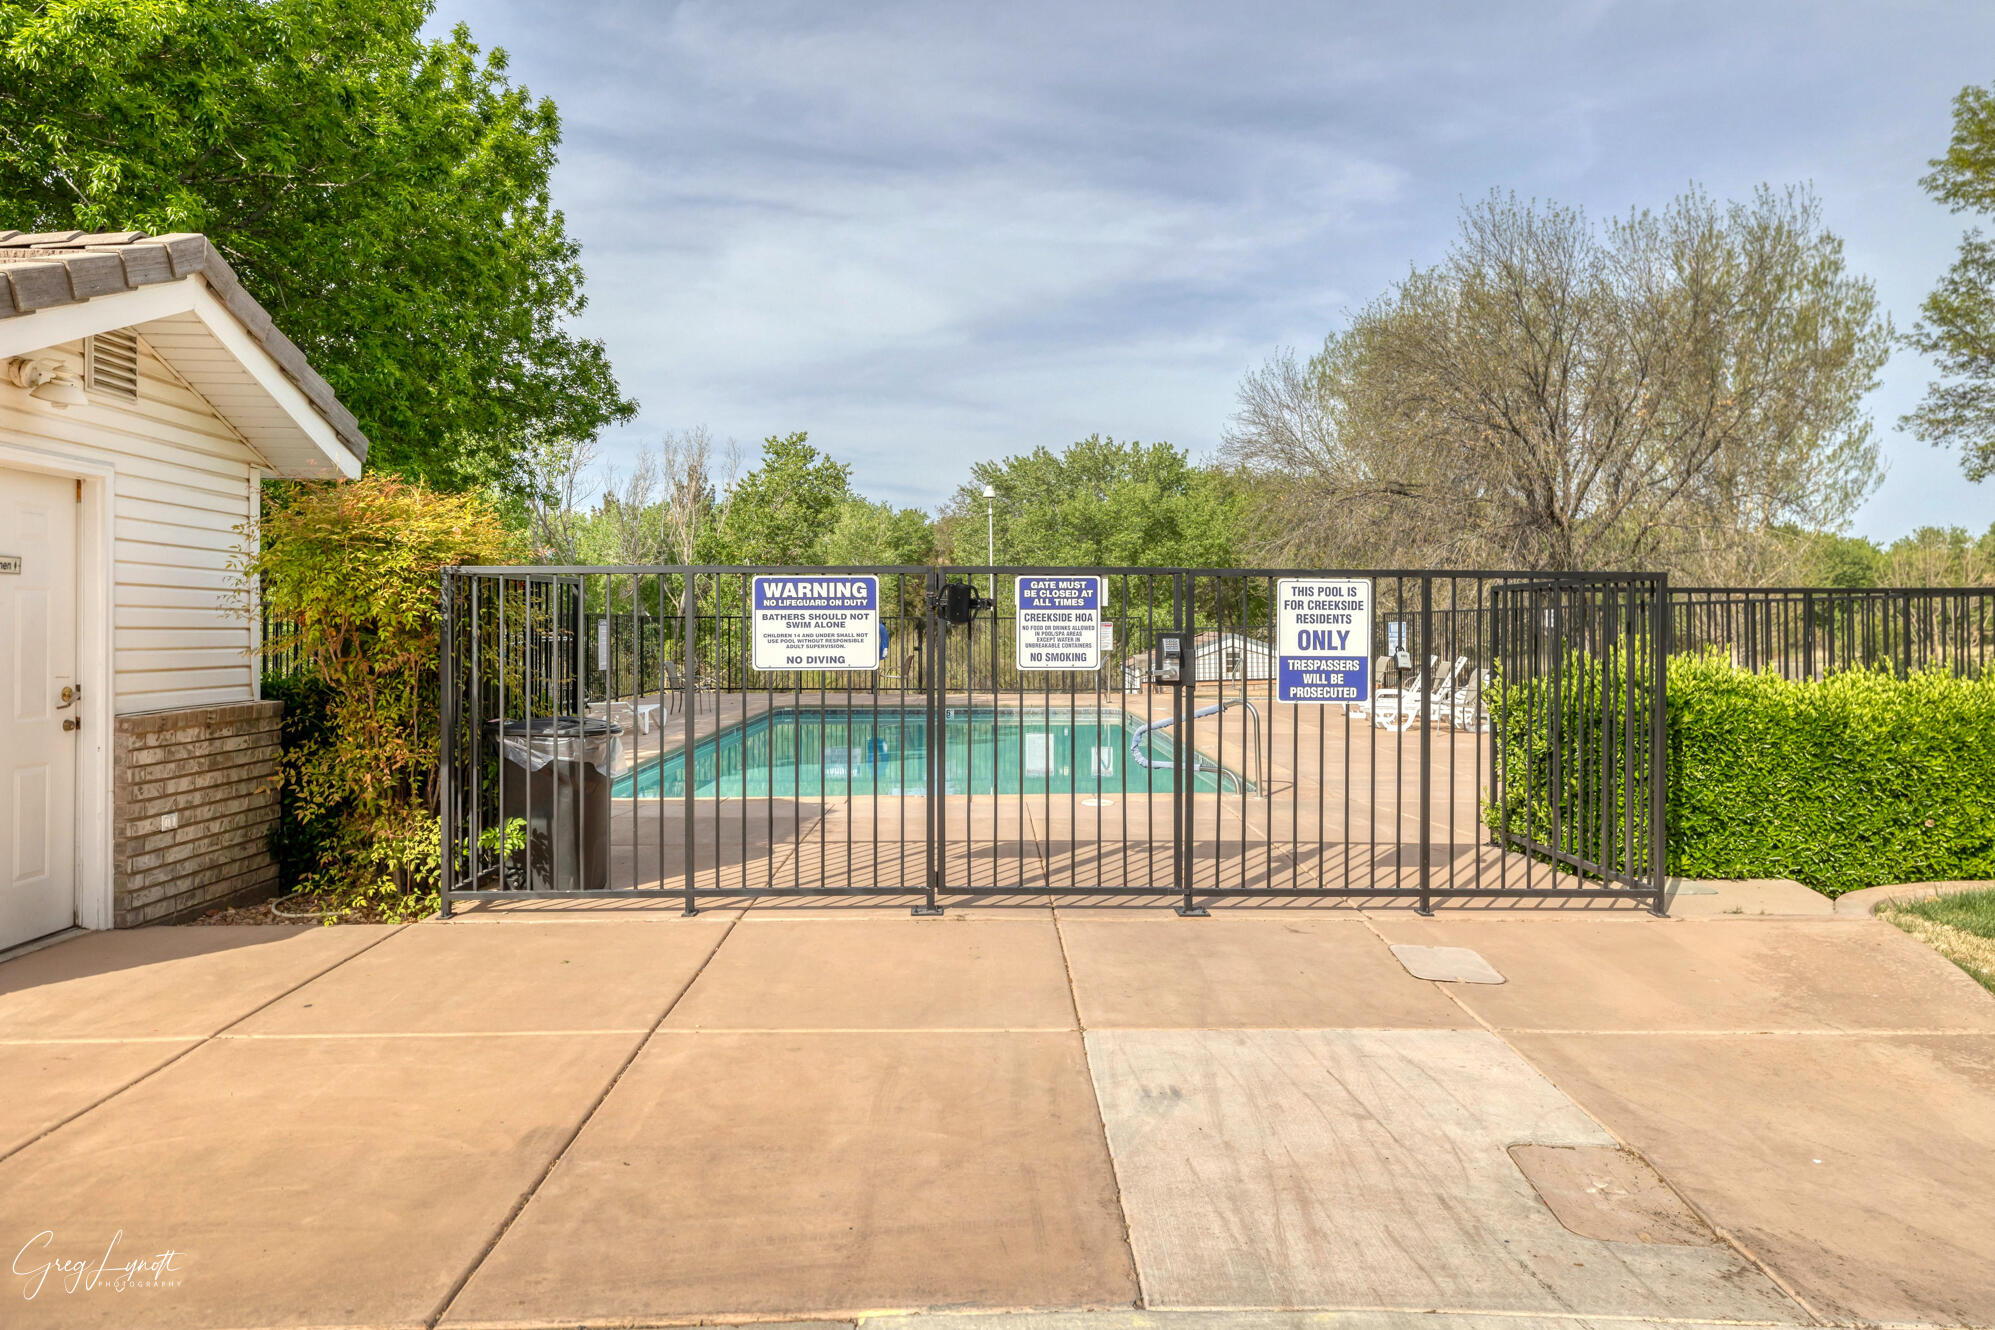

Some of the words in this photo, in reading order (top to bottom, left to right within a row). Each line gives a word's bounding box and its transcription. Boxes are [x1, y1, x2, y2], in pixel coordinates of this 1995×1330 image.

[763, 582, 867, 597] WARNING
[1292, 587, 1314, 597] THIS
[1318, 587, 1344, 597] POOL
[1348, 587, 1357, 597] IS
[1284, 600, 1304, 610] FOR
[1308, 600, 1364, 610] CREEKSIDE
[1024, 613, 1072, 622] CREEKSIDE
[1076, 613, 1093, 622] HOA
[1296, 614, 1352, 624] RESIDENTS
[1298, 630, 1350, 650] ONLY
[1030, 653, 1042, 661] NO
[1045, 653, 1086, 661] SMOKING
[1288, 660, 1360, 670] TRESPASSERS
[1303, 674, 1328, 684] WILL
[1331, 674, 1344, 684] BE
[1290, 687, 1357, 698] PROSECUTED
